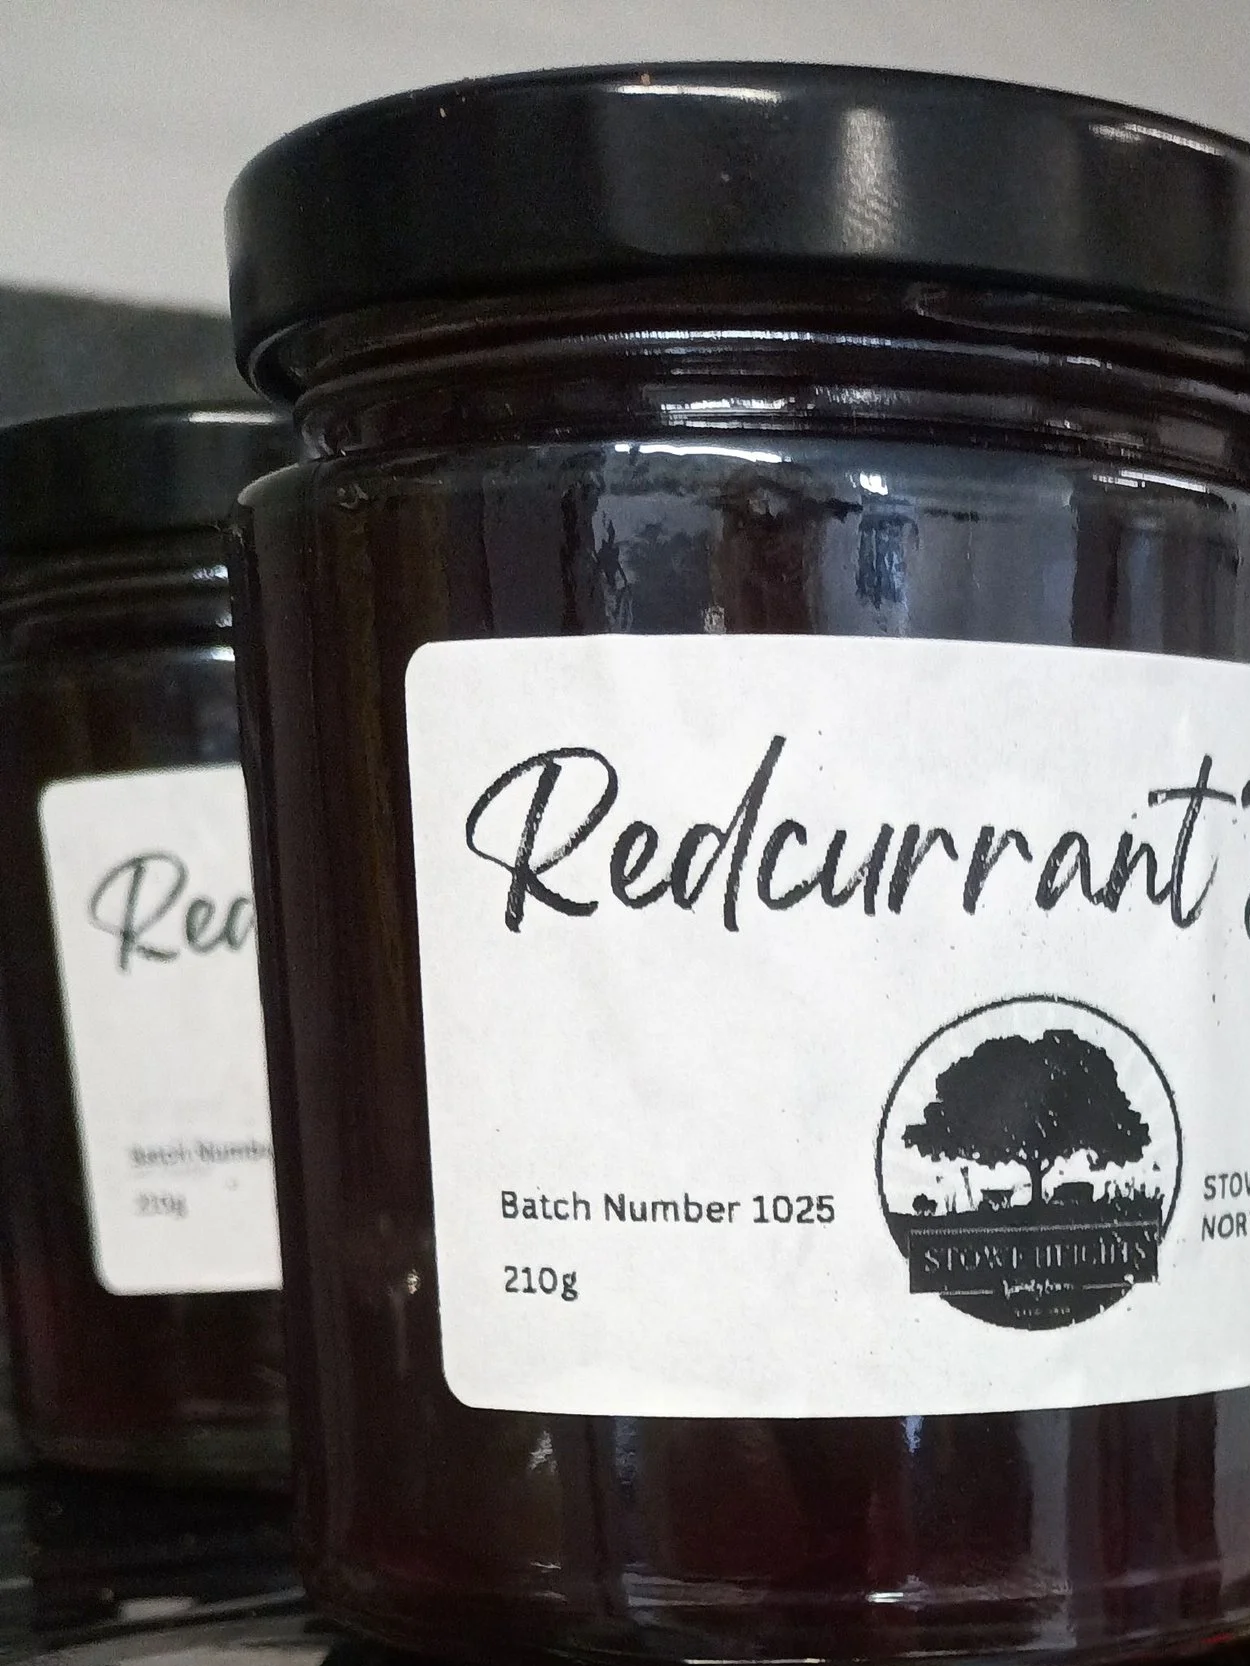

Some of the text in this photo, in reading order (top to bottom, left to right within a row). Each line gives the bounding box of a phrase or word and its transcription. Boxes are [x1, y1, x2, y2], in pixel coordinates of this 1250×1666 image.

[464, 733, 1237, 934] Redcurrant
[501, 1189, 836, 1225] Batch Number 1025
[503, 1264, 580, 1303] 210g
